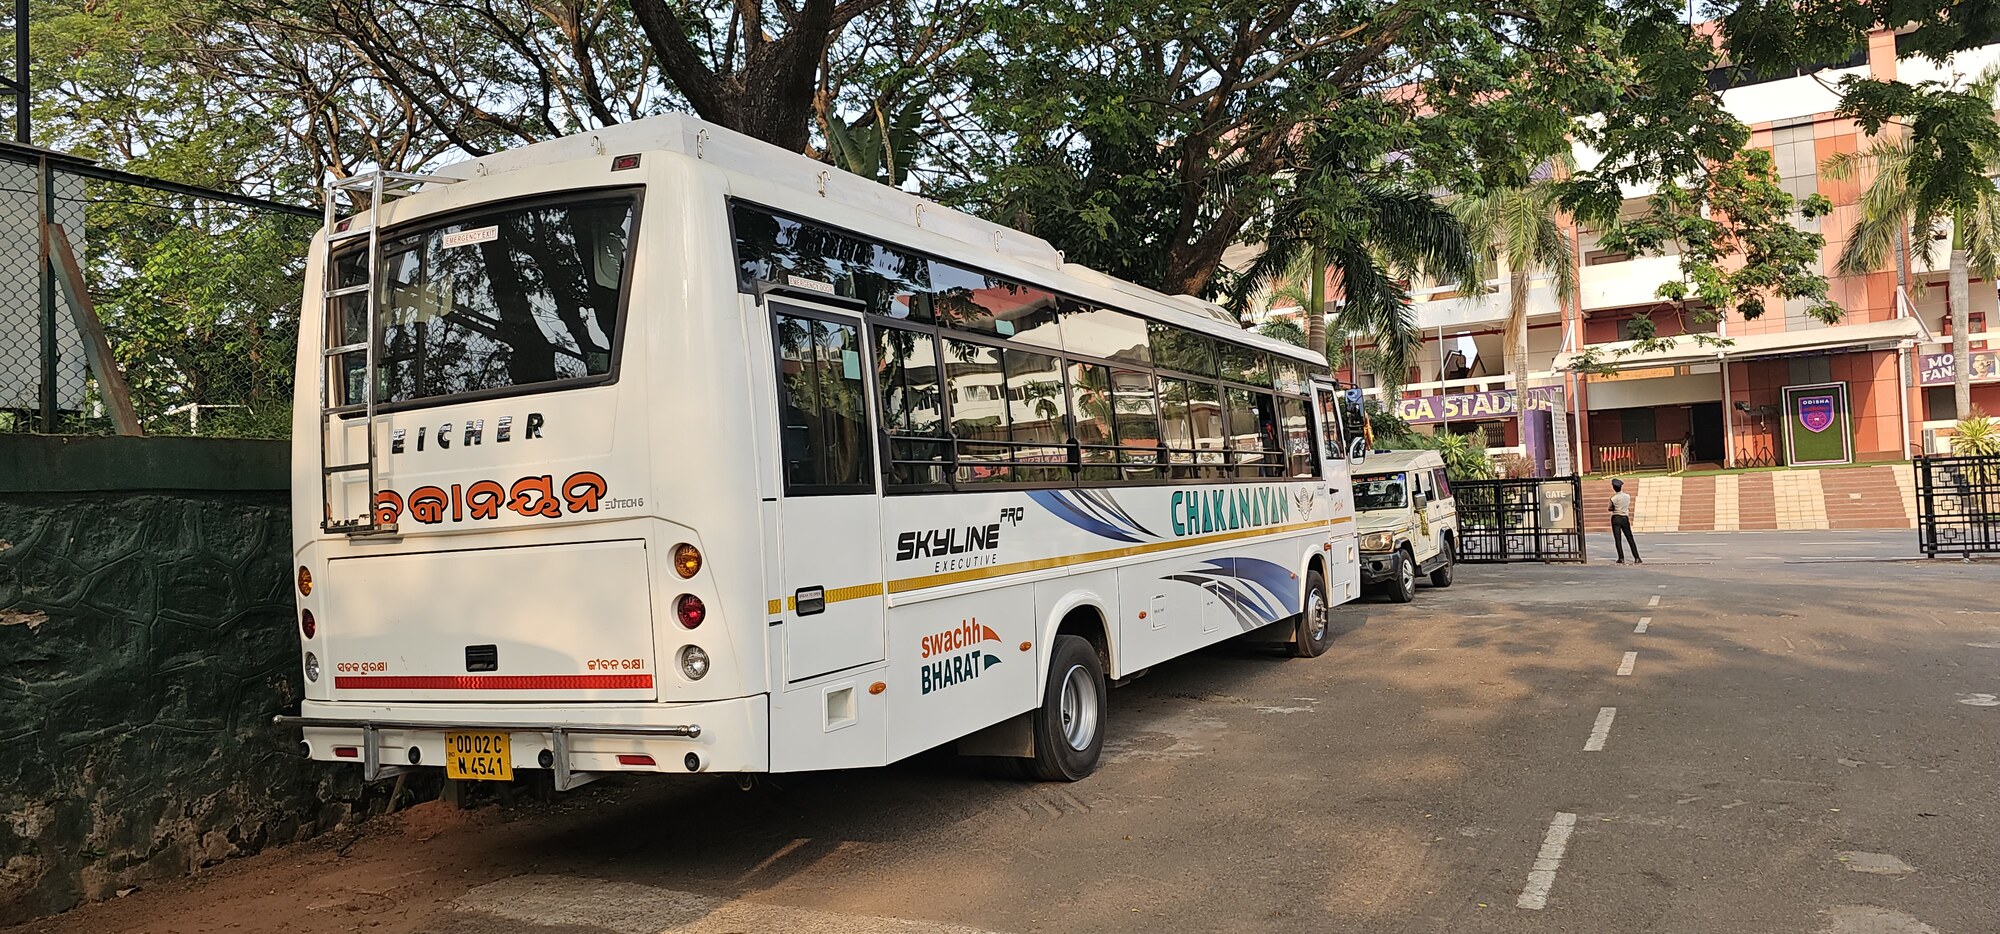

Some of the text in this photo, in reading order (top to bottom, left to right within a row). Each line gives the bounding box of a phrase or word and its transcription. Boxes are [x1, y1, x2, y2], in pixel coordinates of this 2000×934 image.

[446, 229, 495, 245] EMERGENCY EXIT
[1927, 354, 1954, 369] MO
[391, 412, 546, 454] EICHER
[605, 497, 644, 510] EUTECH 6
[1545, 490, 1566, 499] GATE
[1171, 486, 1290, 536] CHAKANAYAN
[1549, 503, 1564, 521] D
[896, 507, 1024, 561] SKYLINE PRO
[935, 554, 997, 572] EXECUTIVE
[921, 617, 980, 658] swachh
[921, 650, 980, 695] BHARAT
[458, 757, 503, 775] N 4541
